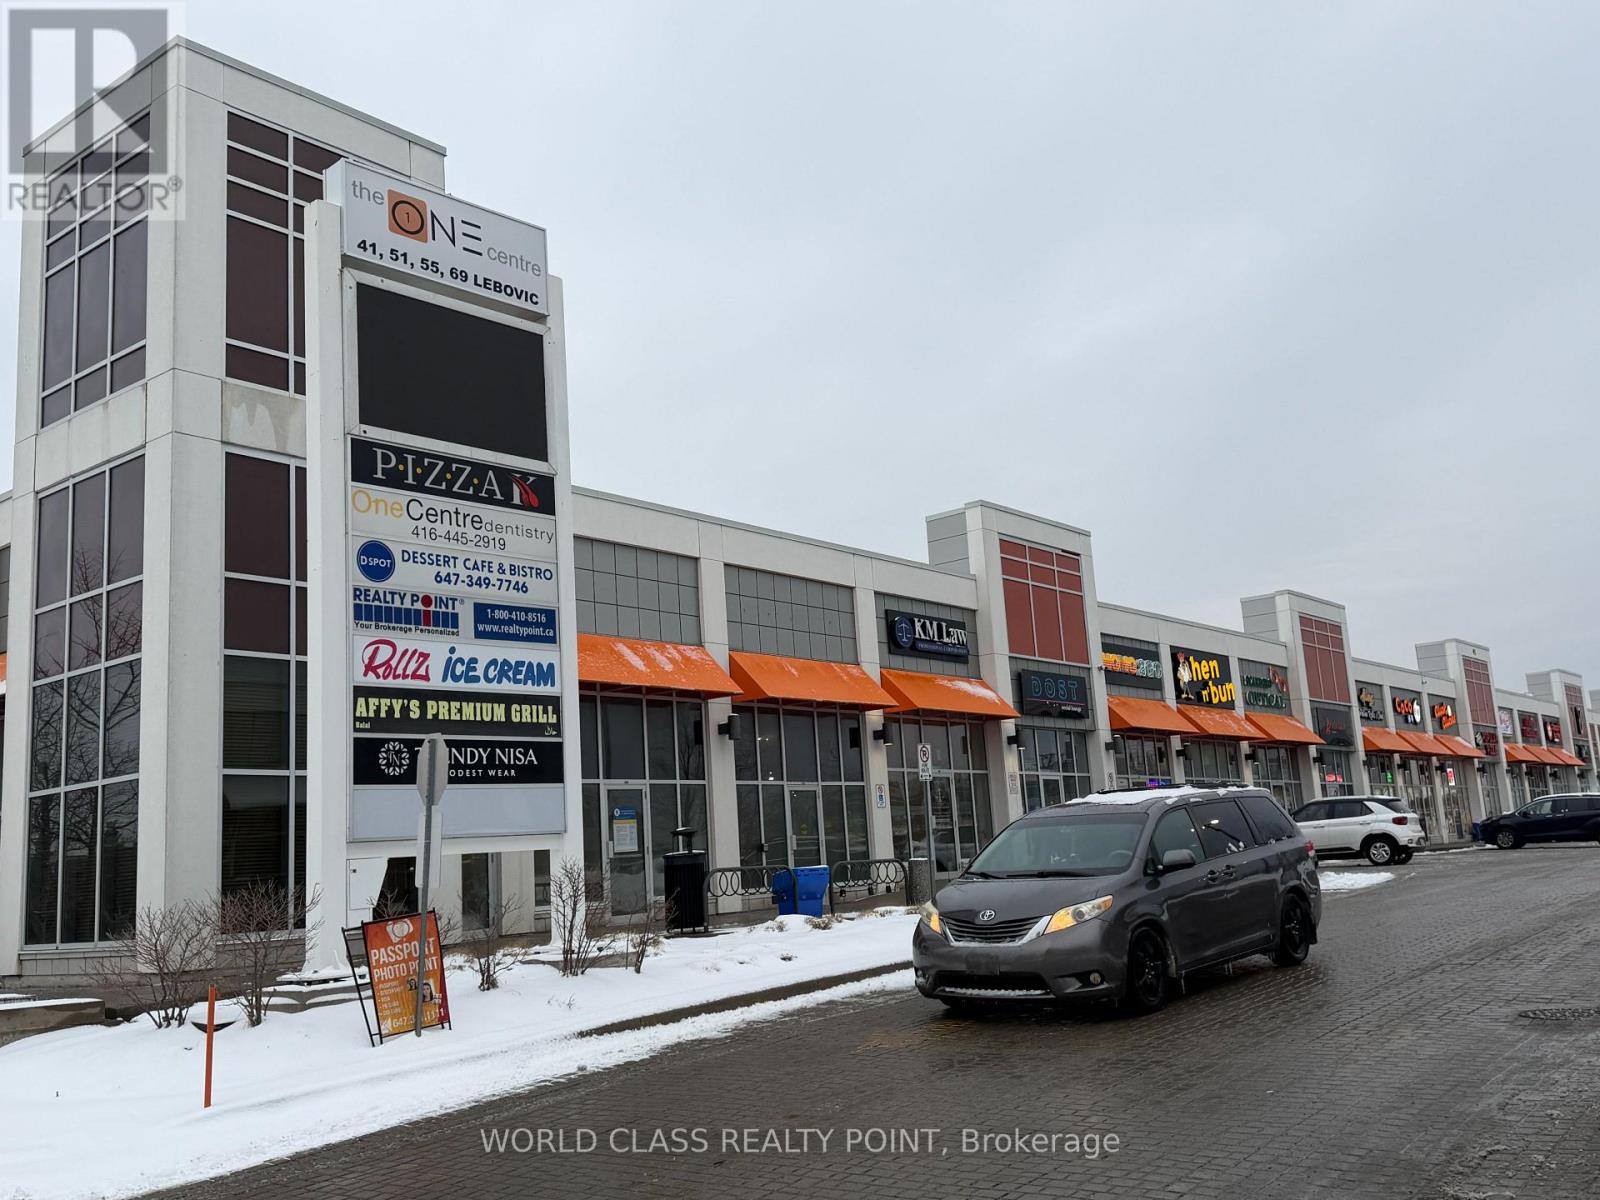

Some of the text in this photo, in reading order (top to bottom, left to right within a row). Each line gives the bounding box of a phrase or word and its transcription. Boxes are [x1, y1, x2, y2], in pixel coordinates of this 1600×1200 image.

[352, 180, 542, 276] the ONE centre
[357, 239, 539, 305] 41, 51, 55, 69 LEBOVIC
[411, 526, 506, 550] 416-445-2919
[401, 550, 553, 581] DESSERT CAFE & BISTRO
[434, 571, 529, 594] 647-349-7746
[353, 587, 407, 605] REALTY
[487, 609, 546, 623] 1-800-410-8516
[354, 621, 460, 637] Your Brokerage Personalized
[477, 623, 554, 637] www.realtypoint.ca
[914, 618, 968, 646] KM Law
[484, 658, 556, 687] CREAM
[1189, 656, 1220, 681] hen
[1031, 676, 1078, 700] DOST
[1209, 681, 1236, 704] bun
[355, 697, 557, 724] AFFY'S PREMIUM GRILL
[495, 747, 538, 765] NISA
[449, 769, 516, 777] ODEST WEAR
[373, 963, 407, 981] PHOTO
